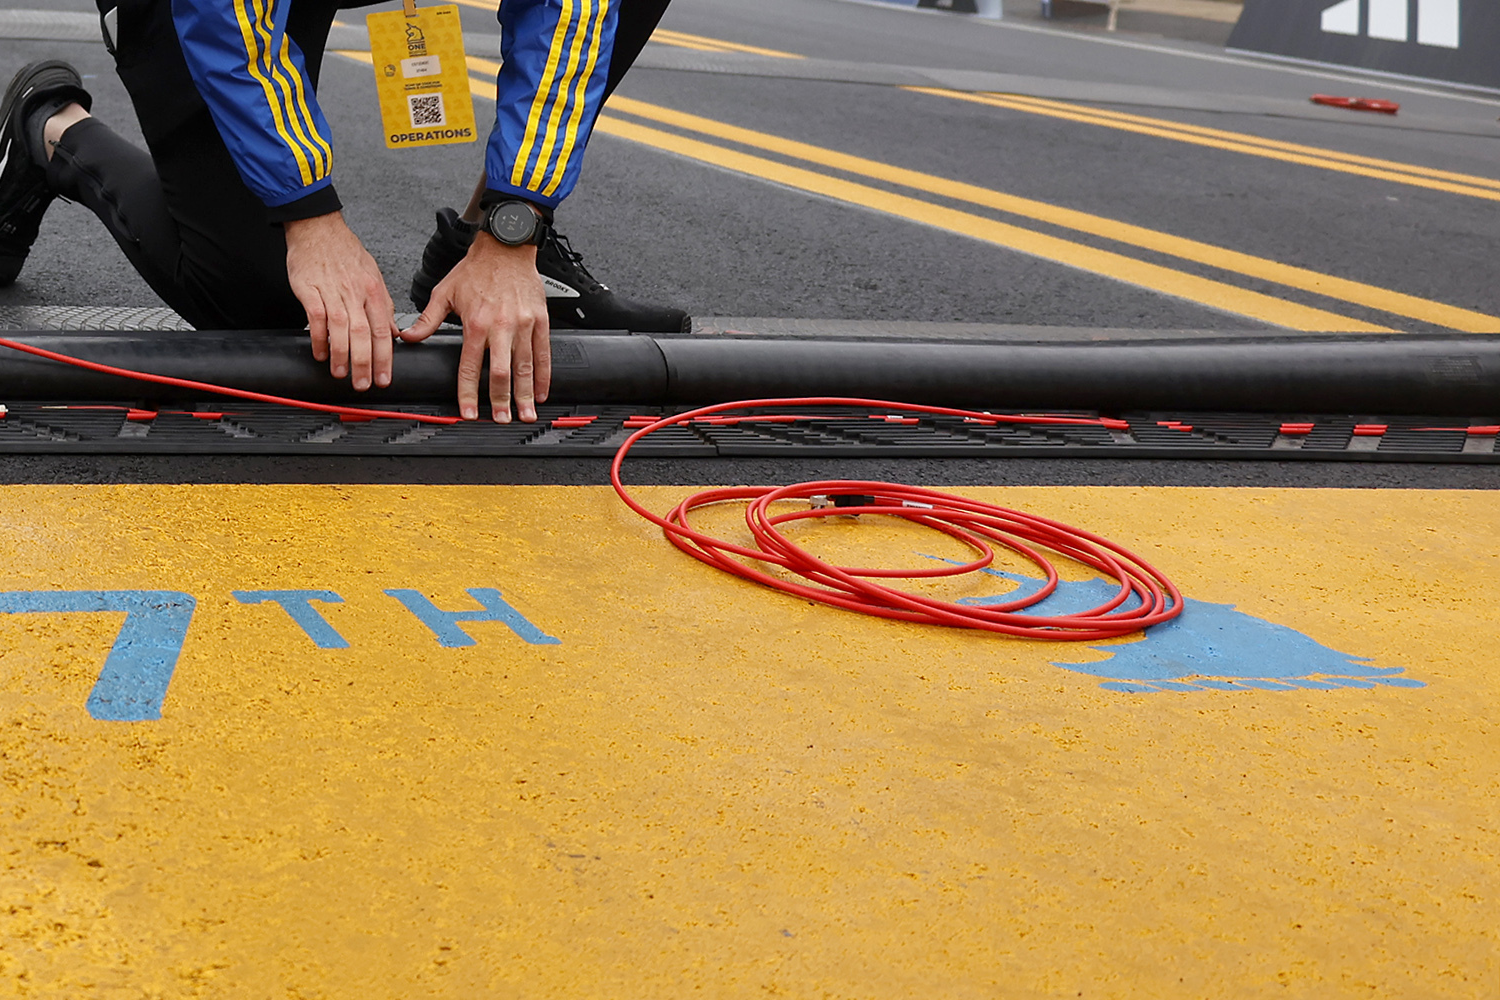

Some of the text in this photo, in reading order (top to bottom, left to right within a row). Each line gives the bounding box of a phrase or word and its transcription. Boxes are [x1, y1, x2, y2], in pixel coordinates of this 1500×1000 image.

[408, 43, 426, 51] ONE
[390, 128, 472, 143] OPERATIONS
[544, 280, 569, 293] BROOKS
